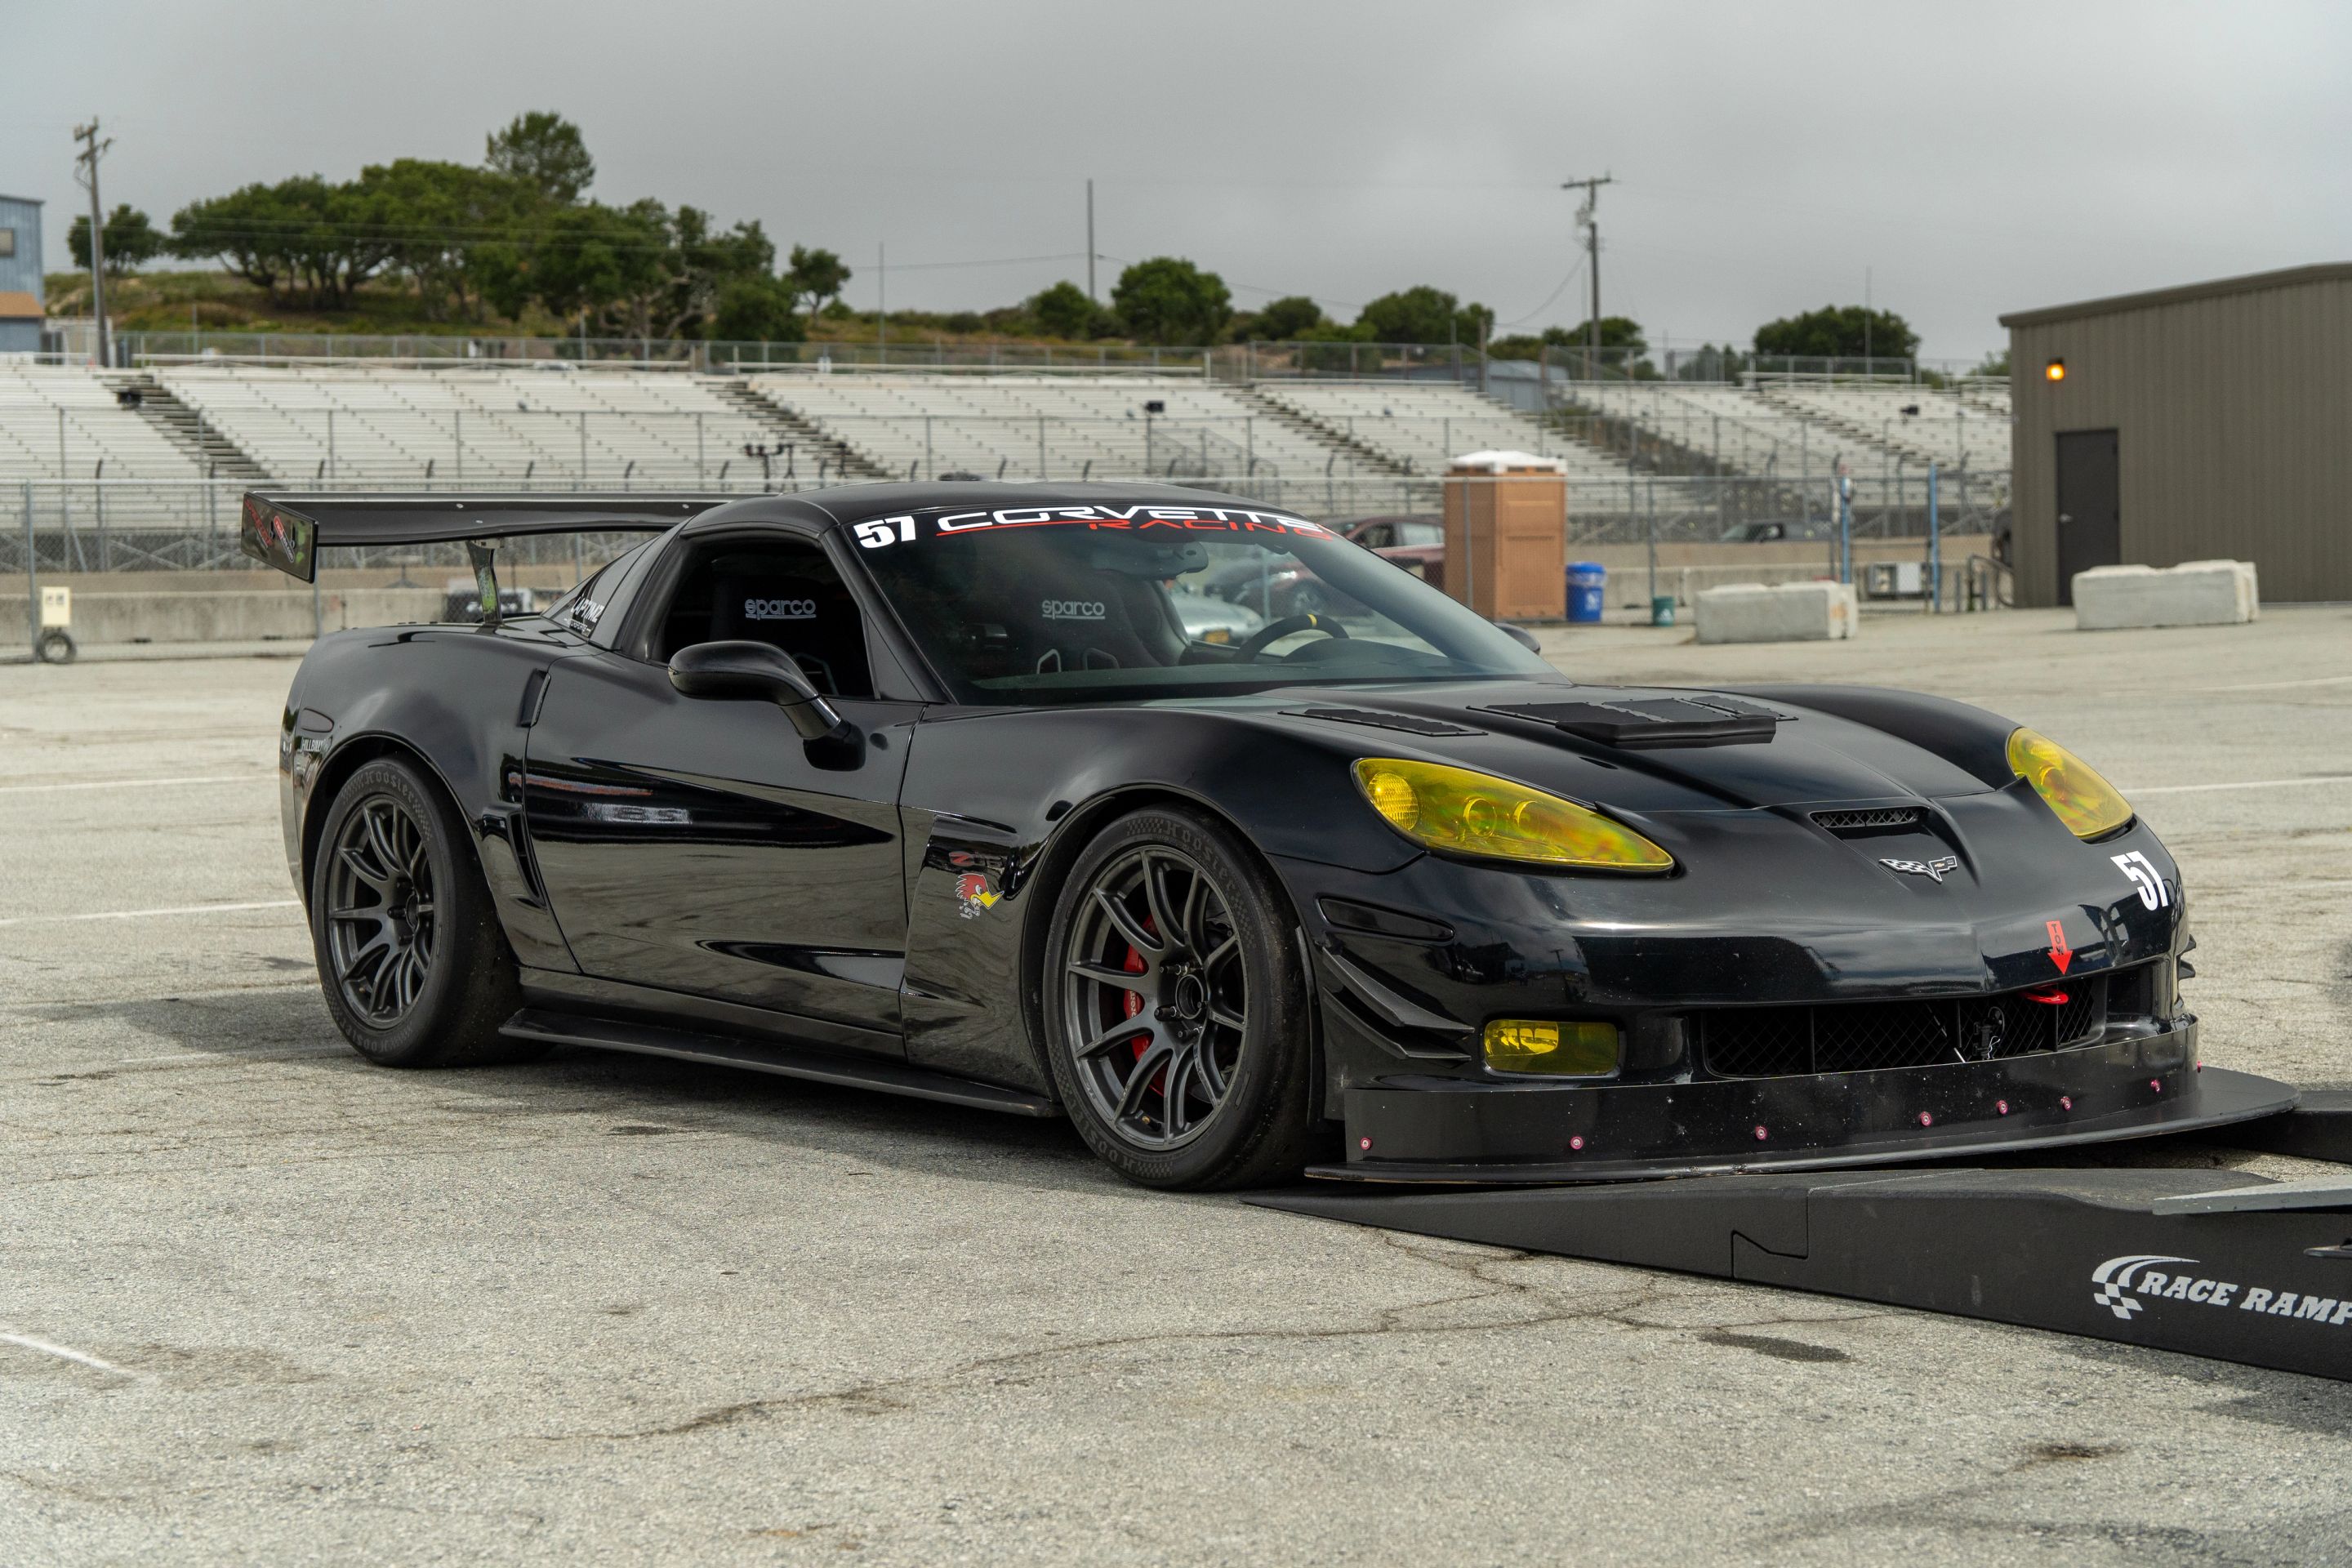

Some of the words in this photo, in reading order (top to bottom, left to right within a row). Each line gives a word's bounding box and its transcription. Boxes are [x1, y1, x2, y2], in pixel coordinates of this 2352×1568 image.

[853, 515, 915, 548] 57
[938, 506, 1323, 532] CORVETTE
[1089, 519, 1334, 541] RACING
[745, 599, 816, 620] sparco
[1042, 600, 1105, 620] sparco
[2109, 851, 2169, 911] 57
[2051, 924, 2065, 956] TOW
[2136, 1271, 2238, 1307] RACE
